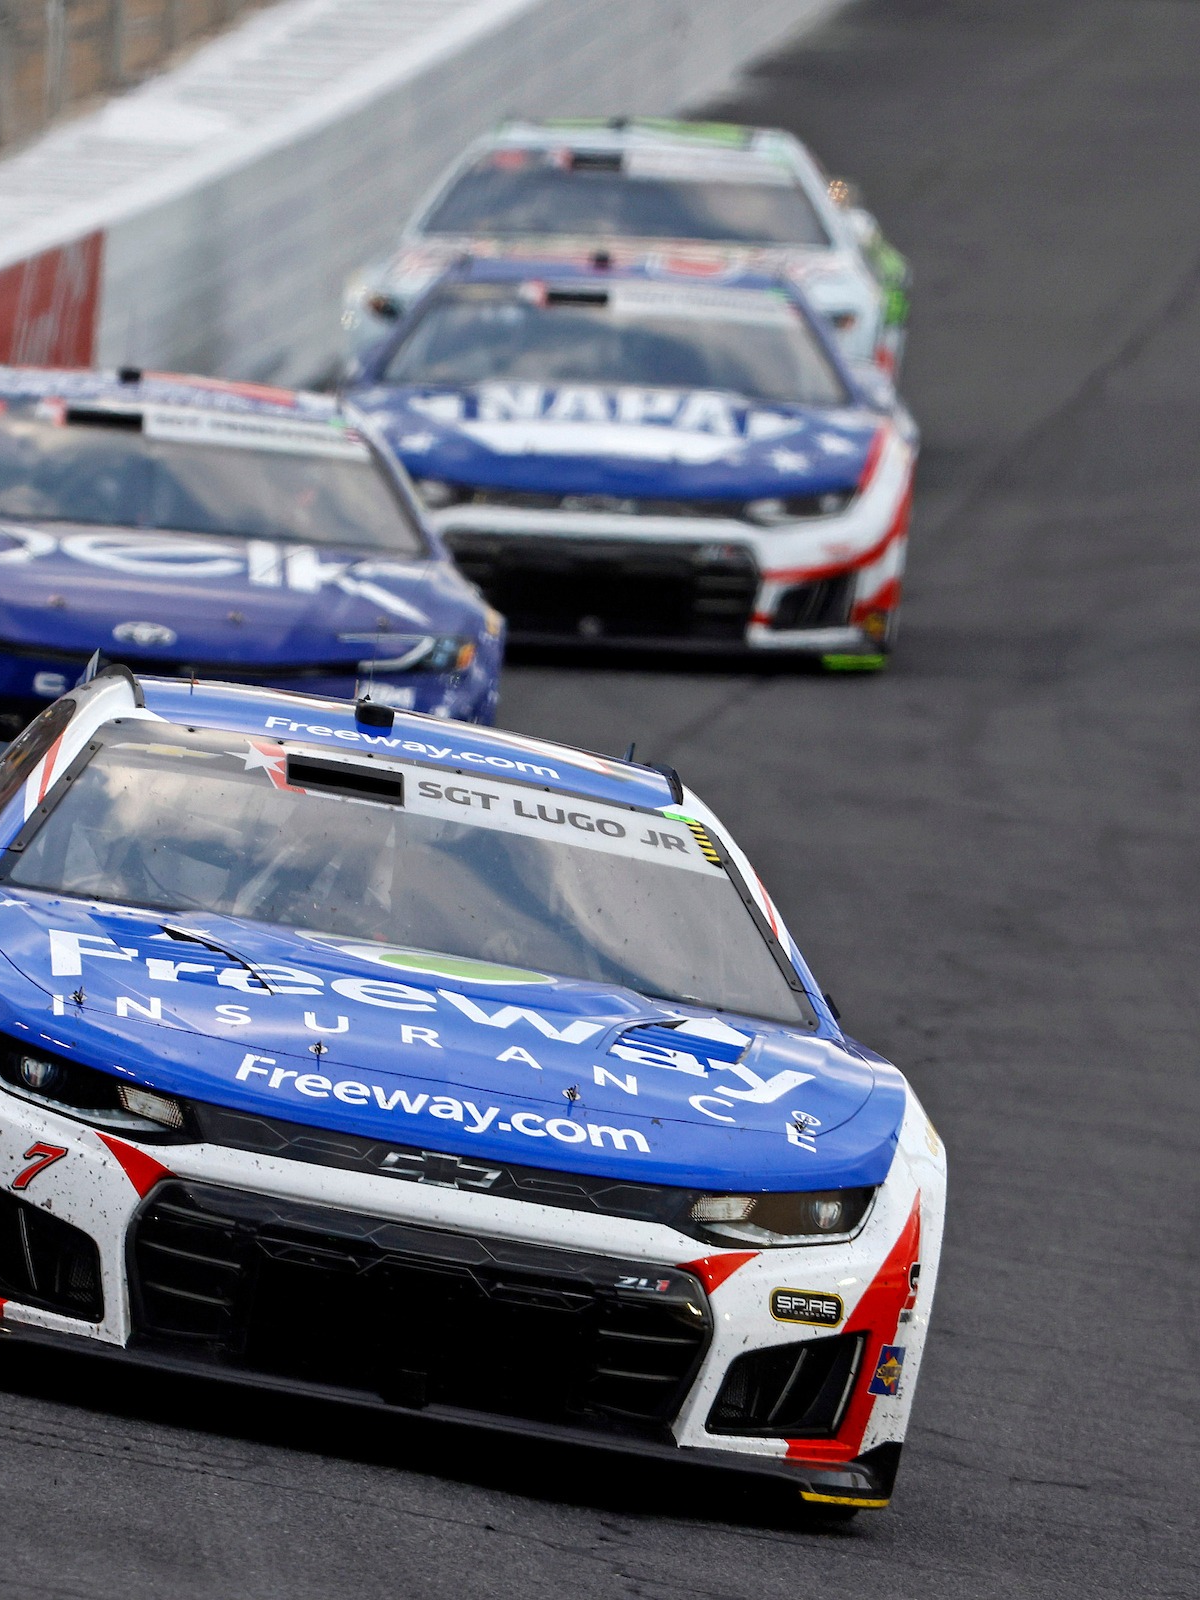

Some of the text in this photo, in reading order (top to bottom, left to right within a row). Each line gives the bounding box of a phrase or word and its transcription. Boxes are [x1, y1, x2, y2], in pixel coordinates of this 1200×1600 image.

[476, 383, 740, 439] NAPA
[265, 715, 560, 780] Freeway.com
[418, 781, 691, 855] SGT LUGO JR
[48, 928, 816, 1104] Freeway
[235, 1053, 651, 1153] Freeway.com
[11, 1141, 68, 1190] 7
[777, 1295, 837, 1315] SPIRE
